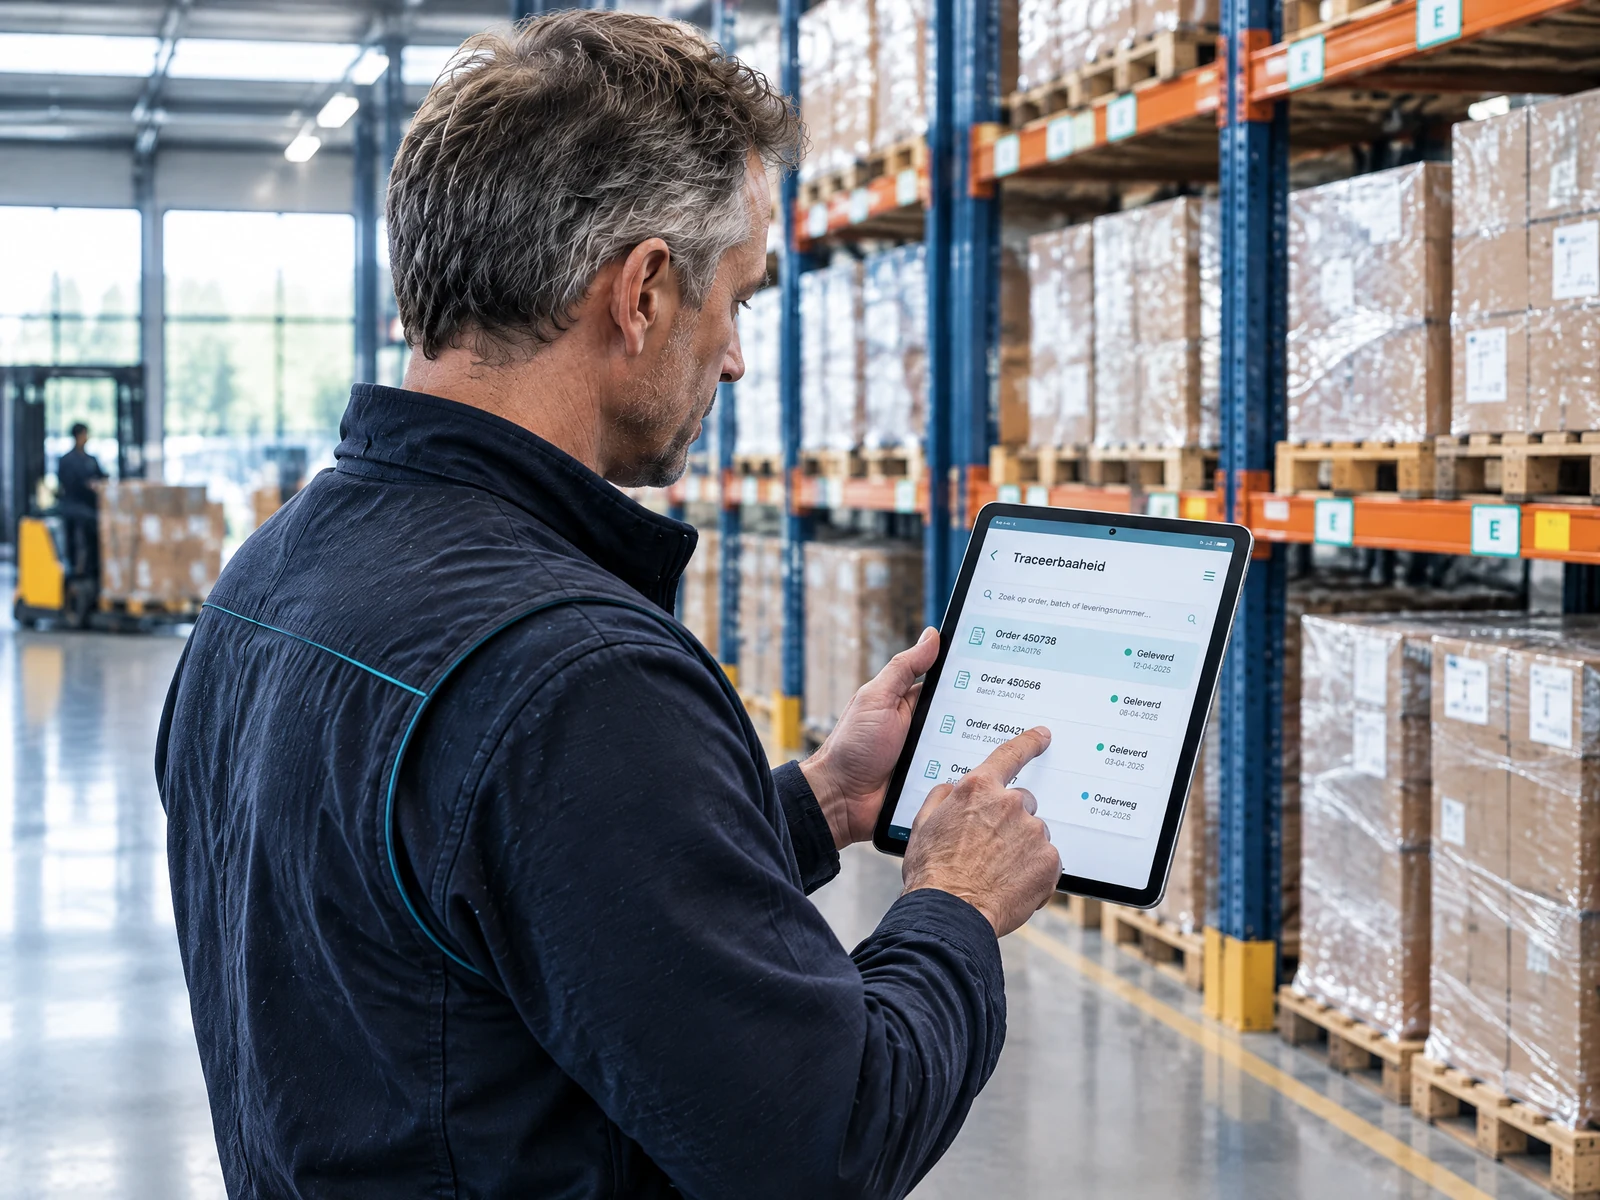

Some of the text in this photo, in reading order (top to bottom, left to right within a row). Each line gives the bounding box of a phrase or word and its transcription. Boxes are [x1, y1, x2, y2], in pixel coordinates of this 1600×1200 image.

[1434, 6, 1444, 28] E
[1489, 519, 1500, 540] E
[1013, 552, 1106, 572] Traceerbaaheid
[998, 592, 1016, 602] Zoek
[1017, 596, 1027, 604] op
[1028, 596, 1049, 607] order,
[1050, 599, 1071, 609] batch
[1072, 602, 1081, 610] of
[995, 629, 1057, 646] Order 450738
[991, 642, 1042, 656] Batch 23A0176
[1137, 649, 1175, 662] Geleverd
[1133, 661, 1172, 674] 12-04-2025
[980, 673, 1006, 685] Order
[976, 686, 1026, 701] Batch 23A0142
[1123, 696, 1162, 709] Geleverd
[1119, 708, 1159, 721] 08-04-2025
[966, 718, 1025, 736] Order 450421
[961, 732, 981, 741] Batch
[1109, 744, 1149, 758] Geleverd
[1104, 757, 1145, 771] 03-04-2025
[1094, 793, 1138, 810] Onderweg
[1090, 806, 1131, 821] 01-04-2025
